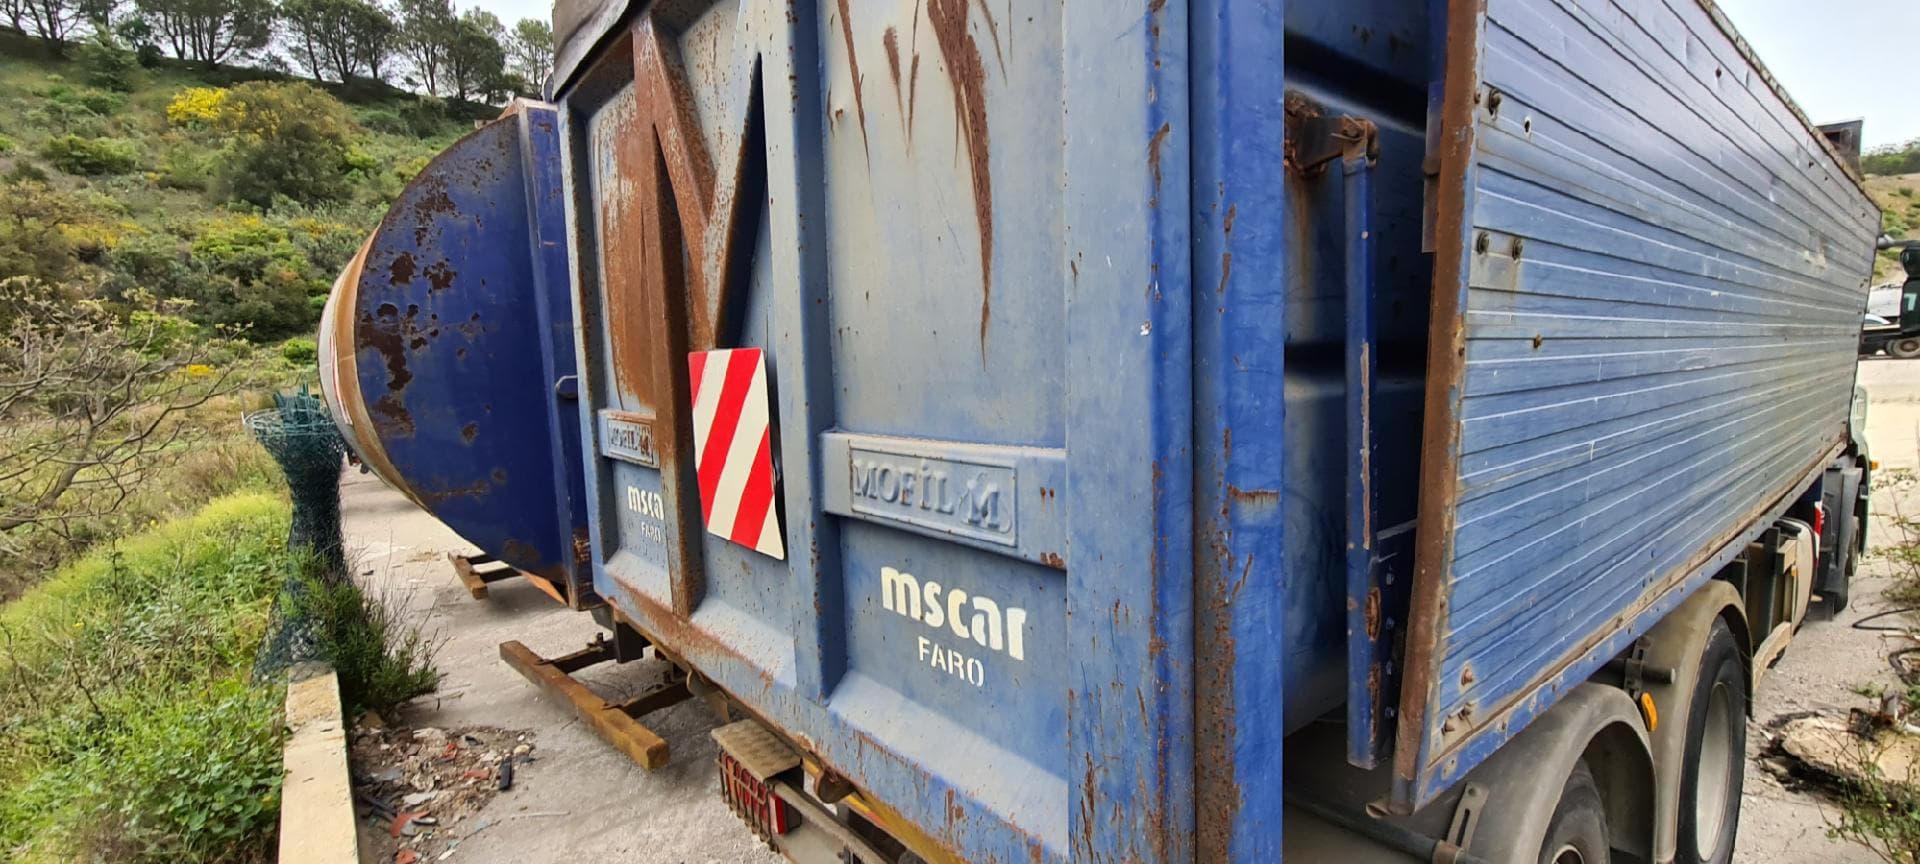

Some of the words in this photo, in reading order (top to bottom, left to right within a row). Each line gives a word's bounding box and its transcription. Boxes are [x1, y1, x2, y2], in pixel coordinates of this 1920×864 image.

[628, 486, 665, 521] msca
[881, 567, 1027, 660] mscar
[918, 636, 985, 687] FARO
